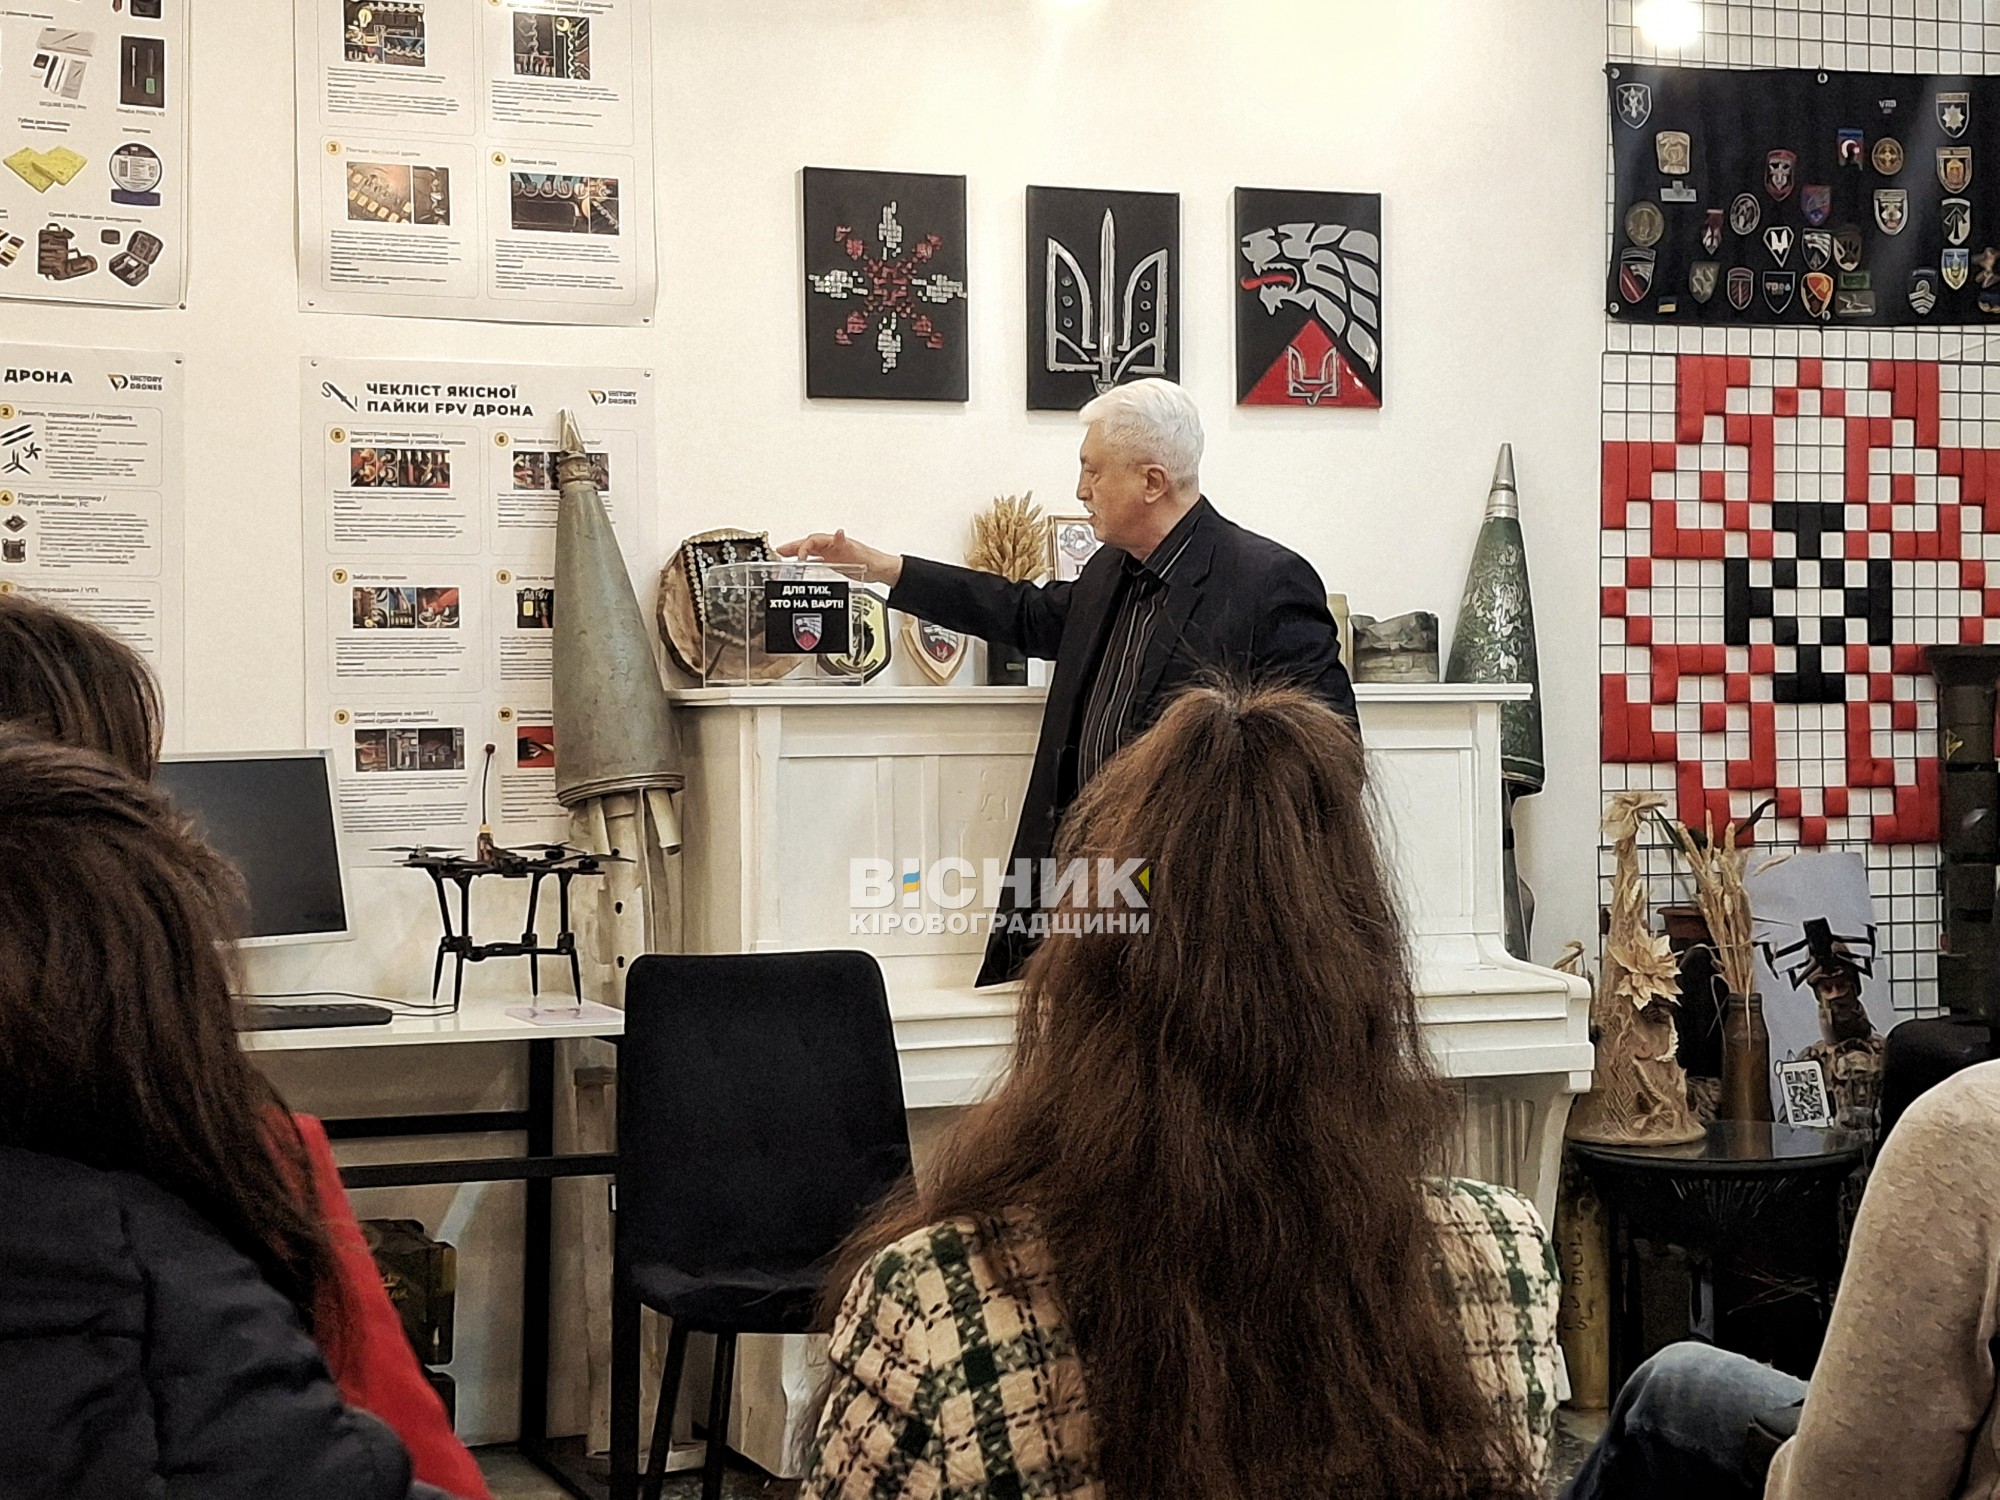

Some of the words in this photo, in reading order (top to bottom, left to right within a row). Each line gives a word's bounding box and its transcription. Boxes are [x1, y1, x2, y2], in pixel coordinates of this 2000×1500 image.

[4, 368, 73, 384] ДРОНА
[129, 383, 163, 391] DRONES
[366, 383, 442, 397] ЧЕКЛІСТ
[447, 384, 518, 399] ЯКІСНОЇ
[2, 407, 10, 416] 2
[367, 399, 430, 414] ПАЙКИ
[435, 402, 468, 415] FPV
[473, 403, 534, 417] ДРОНА
[336, 572, 344, 581] 7
[782, 585, 806, 596] ДЛЯ
[807, 585, 832, 596] ТИХ,
[769, 599, 791, 609] ХТО
[793, 599, 809, 609] НА
[500, 710, 510, 719] 10
